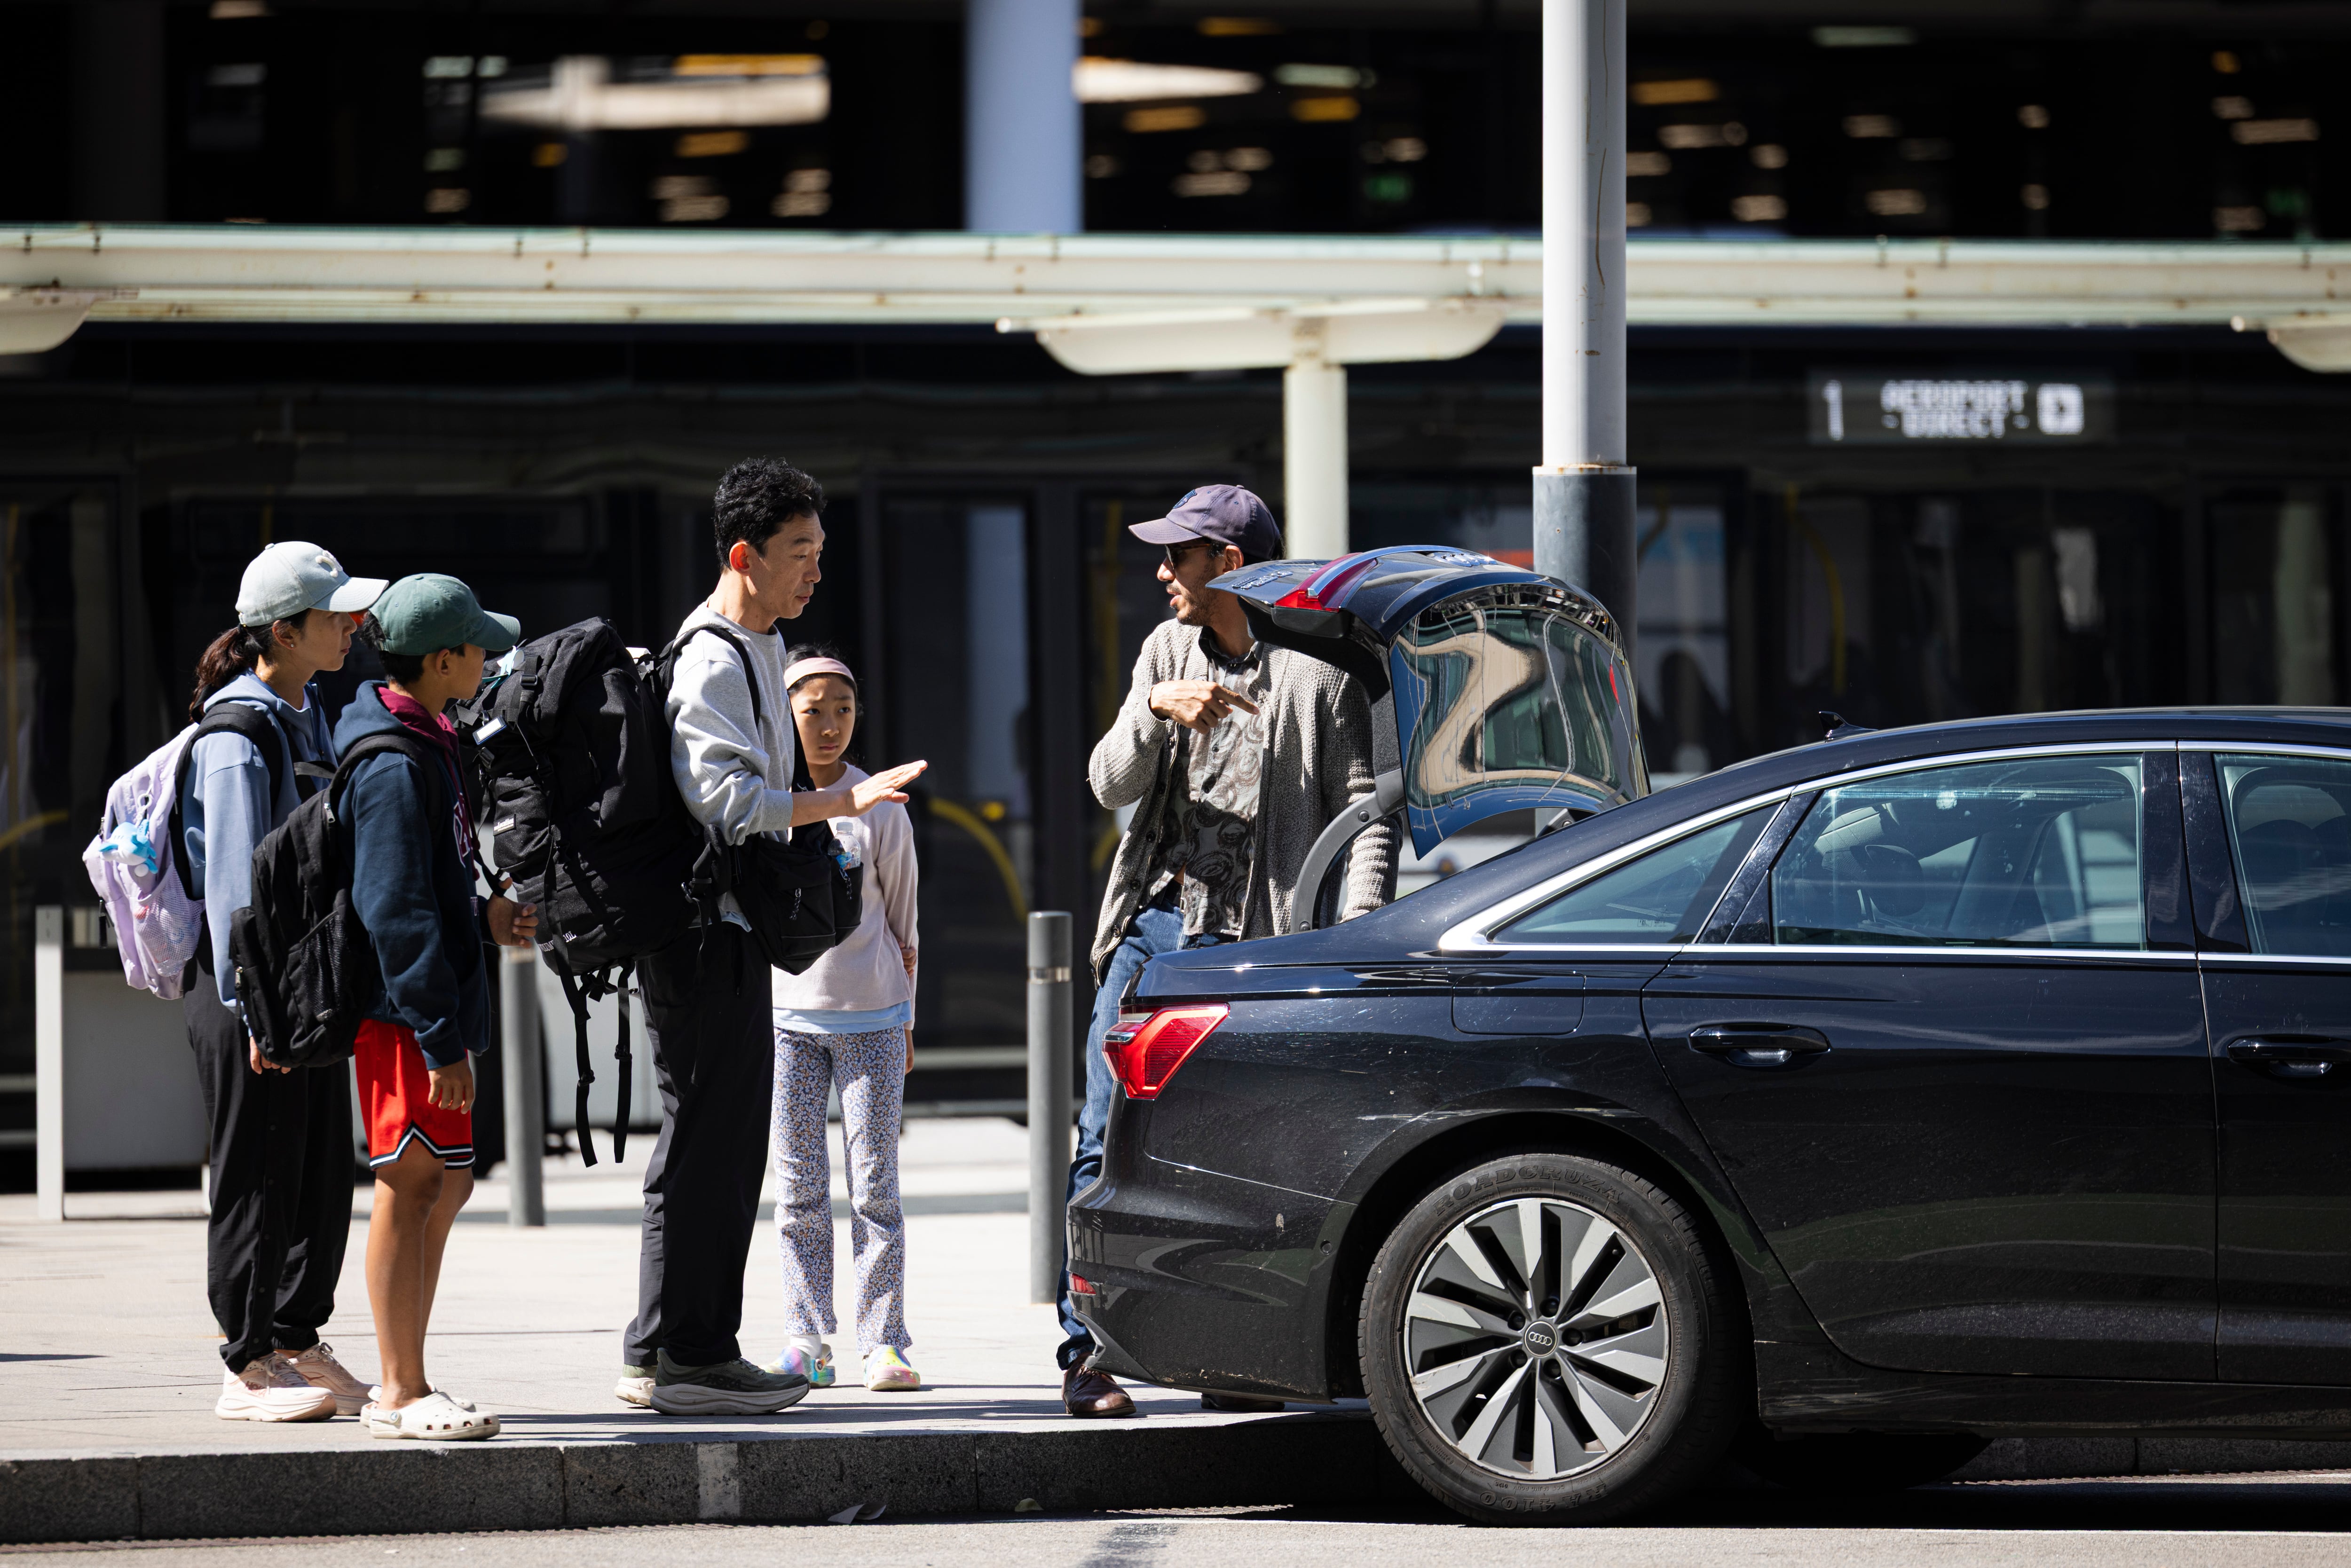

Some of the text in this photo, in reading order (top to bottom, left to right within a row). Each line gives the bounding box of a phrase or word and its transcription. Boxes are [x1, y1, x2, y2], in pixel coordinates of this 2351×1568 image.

[1432, 1165, 1624, 1215] ROADCRUZA
[1568, 1190, 1594, 1204] TUBELESS
[1669, 1305, 1683, 1385] 225/55ZR18 102W
